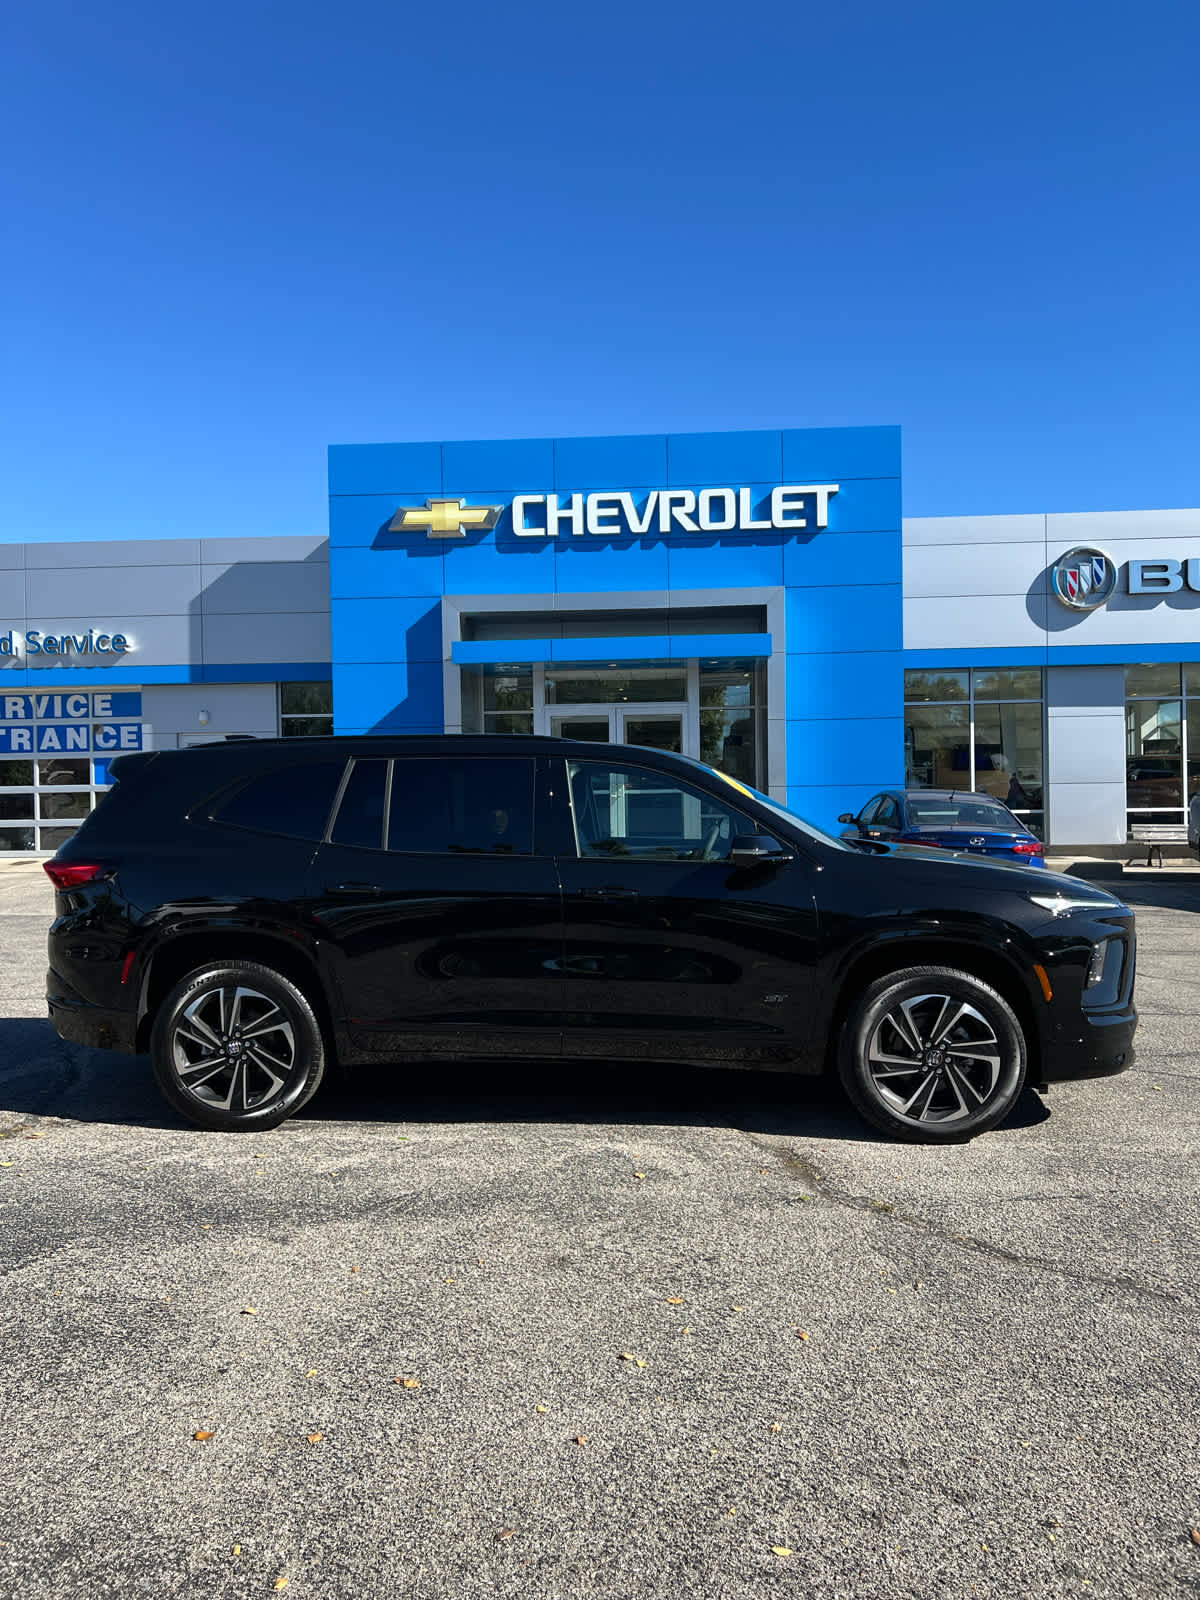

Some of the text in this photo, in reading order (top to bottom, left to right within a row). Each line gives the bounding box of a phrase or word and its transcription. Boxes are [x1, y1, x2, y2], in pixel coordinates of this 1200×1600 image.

[512, 484, 839, 537] CHEVROLET
[1129, 559, 1200, 593] B
[25, 629, 127, 655] Service
[0, 694, 112, 718] RVICE
[0, 727, 138, 751] RANCE
